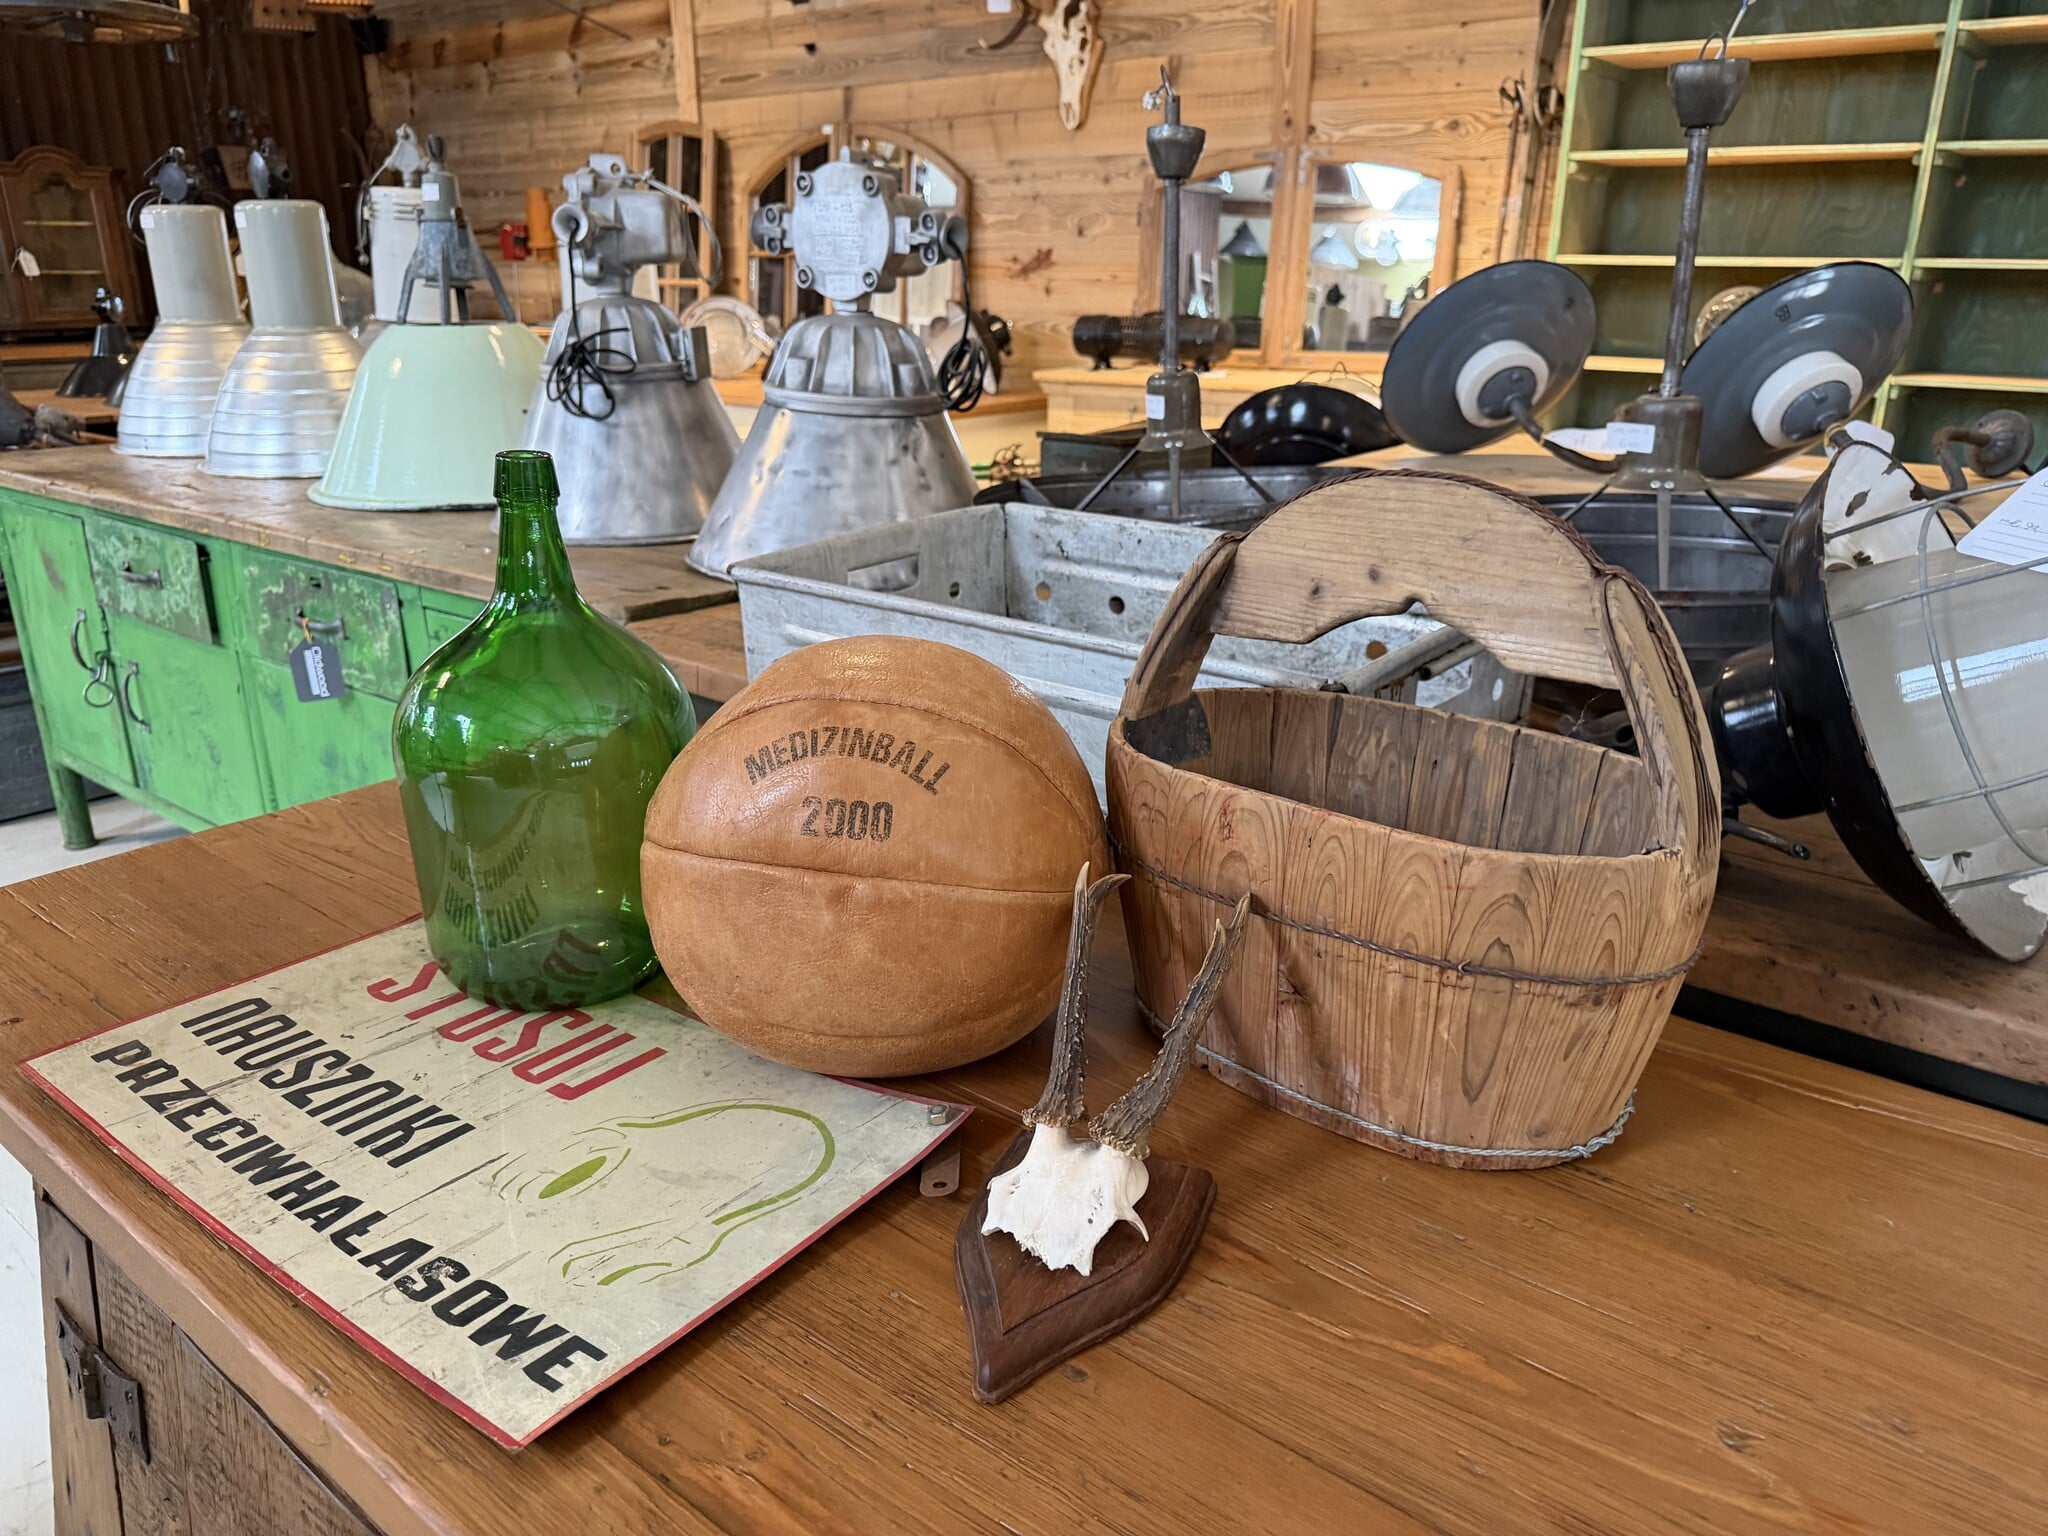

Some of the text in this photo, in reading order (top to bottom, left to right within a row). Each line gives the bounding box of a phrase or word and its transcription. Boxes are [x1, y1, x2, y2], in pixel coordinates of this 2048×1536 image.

[743, 725, 950, 796] MEDIZINBALL
[800, 795, 893, 842] 2000
[180, 997, 476, 1168] NAUSZNIKI
